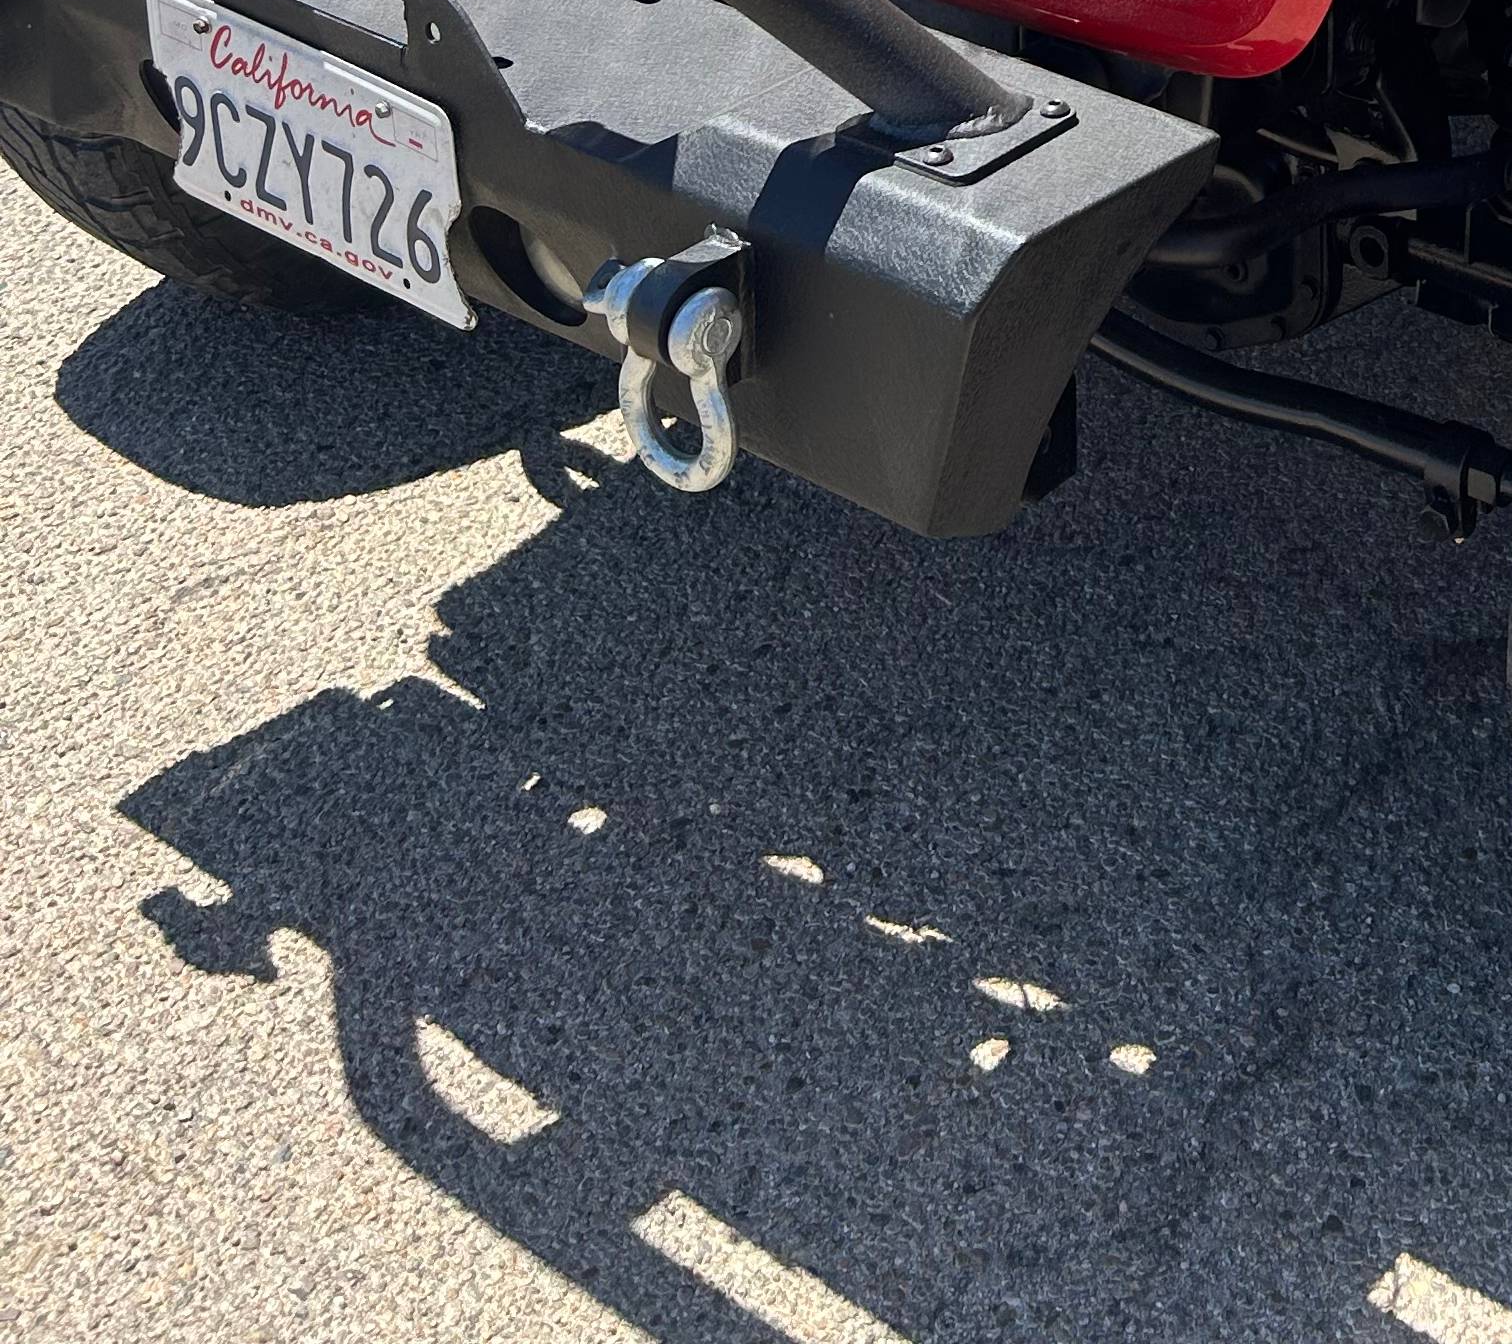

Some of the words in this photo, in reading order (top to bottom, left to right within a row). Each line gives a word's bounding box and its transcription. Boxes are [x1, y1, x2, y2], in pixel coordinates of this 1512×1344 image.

[209, 25, 397, 148] California
[174, 75, 441, 284] 9CZY726
[240, 198, 394, 281] dmv.ca.gov
